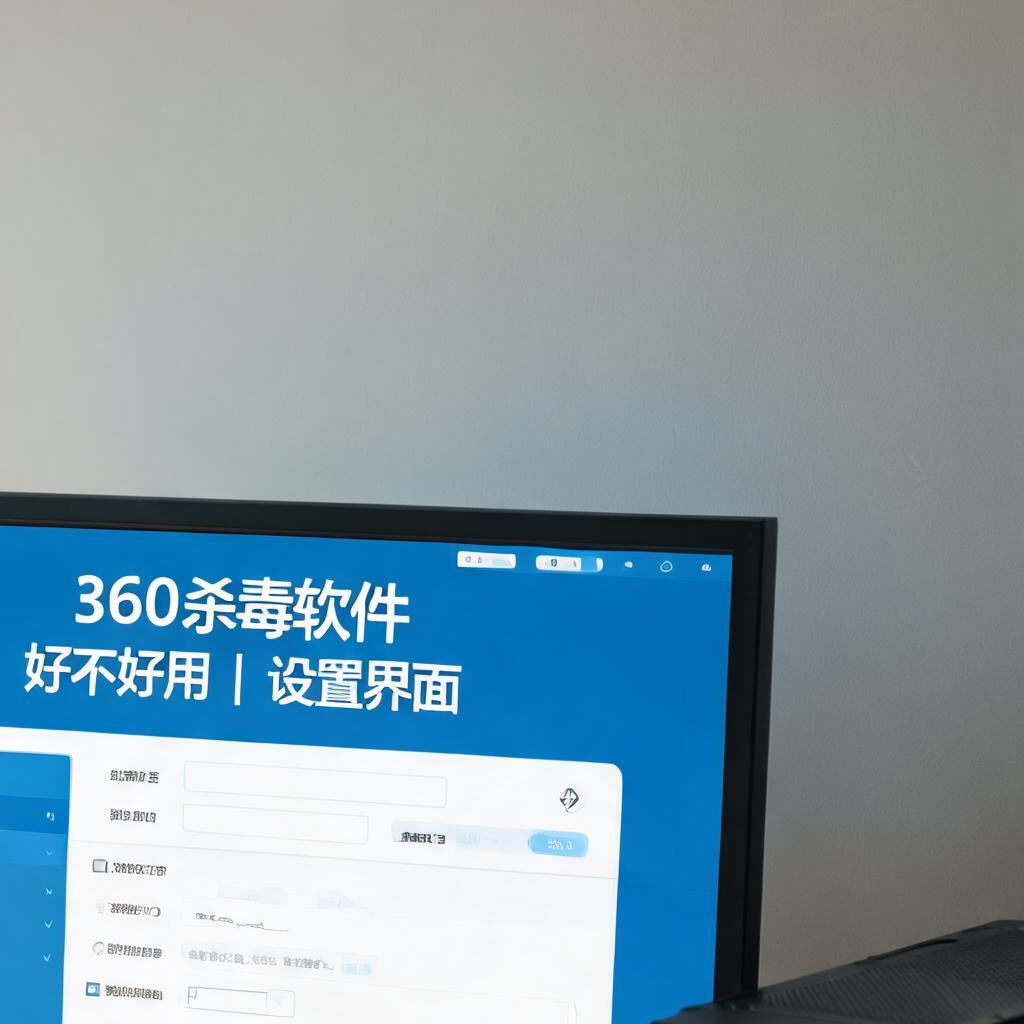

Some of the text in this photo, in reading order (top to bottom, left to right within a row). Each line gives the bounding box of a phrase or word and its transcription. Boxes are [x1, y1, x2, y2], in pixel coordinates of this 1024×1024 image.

[75, 574, 410, 644] 360杀毒软件
[24, 642, 210, 701] 好不好用
[267, 656, 463, 715] 设置界面
